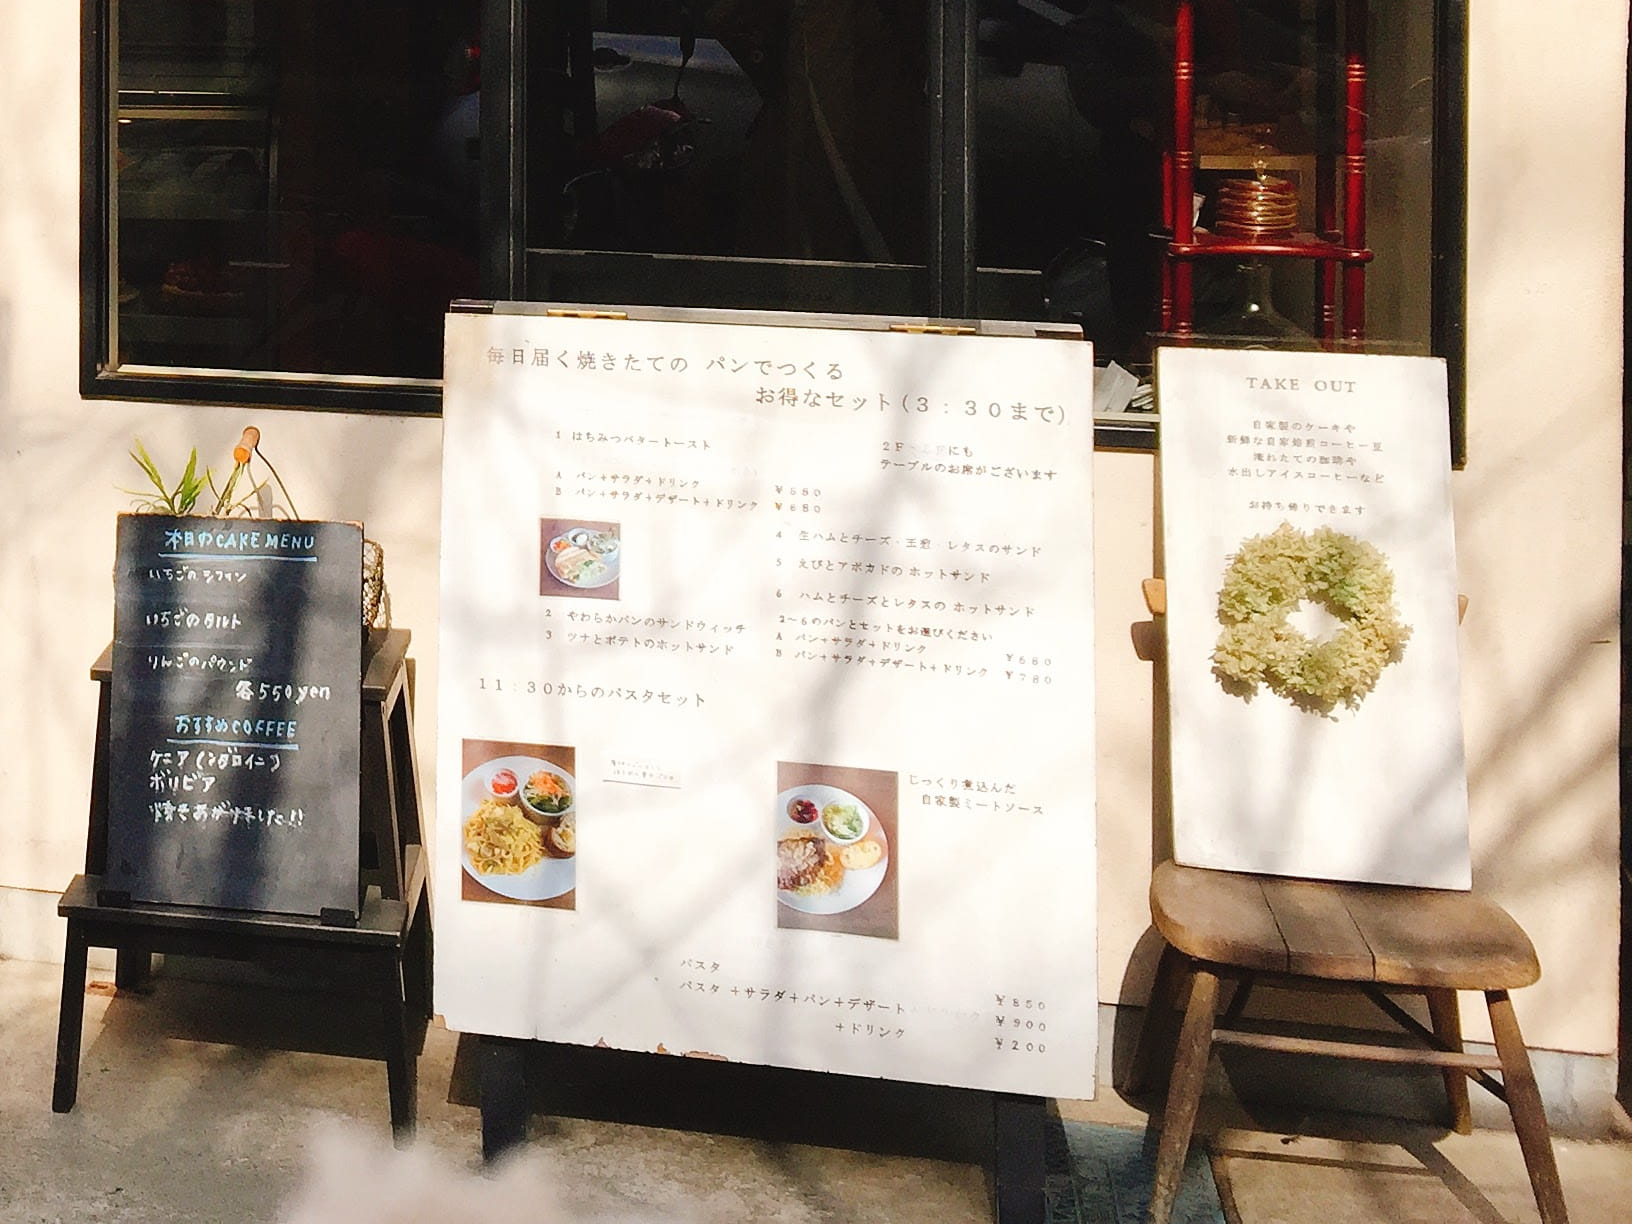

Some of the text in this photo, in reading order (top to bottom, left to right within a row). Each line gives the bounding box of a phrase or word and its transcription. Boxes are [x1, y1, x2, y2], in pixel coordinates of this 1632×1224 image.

[487, 346, 843, 380] 毎日届く焼きたての パンでつくる
[1245, 376, 1357, 393] TAKE OUT
[680, 958, 721, 974] パスタ
